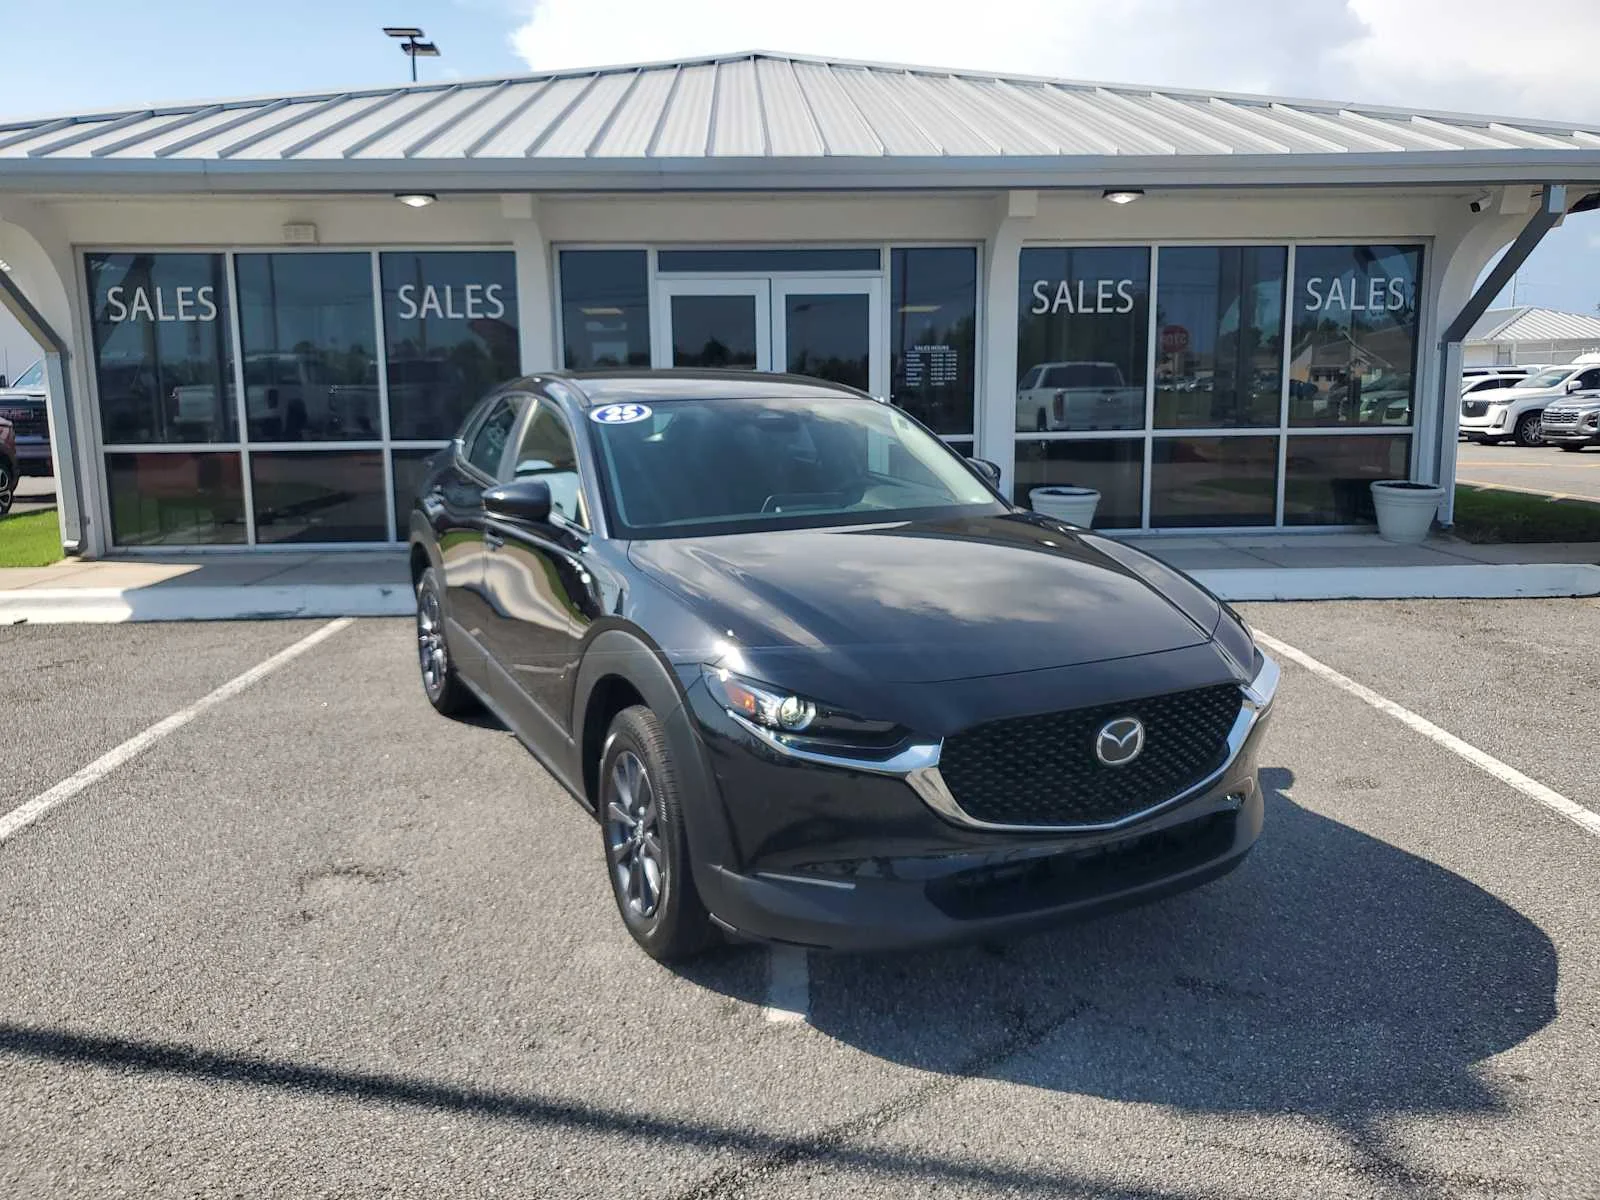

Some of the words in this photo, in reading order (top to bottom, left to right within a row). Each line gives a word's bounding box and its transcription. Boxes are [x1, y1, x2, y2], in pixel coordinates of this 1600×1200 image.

[107, 286, 217, 321] SALES
[399, 284, 505, 319] SALES
[1031, 279, 1134, 314] SALES
[1305, 277, 1404, 311] SALES
[604, 405, 638, 421] 25
